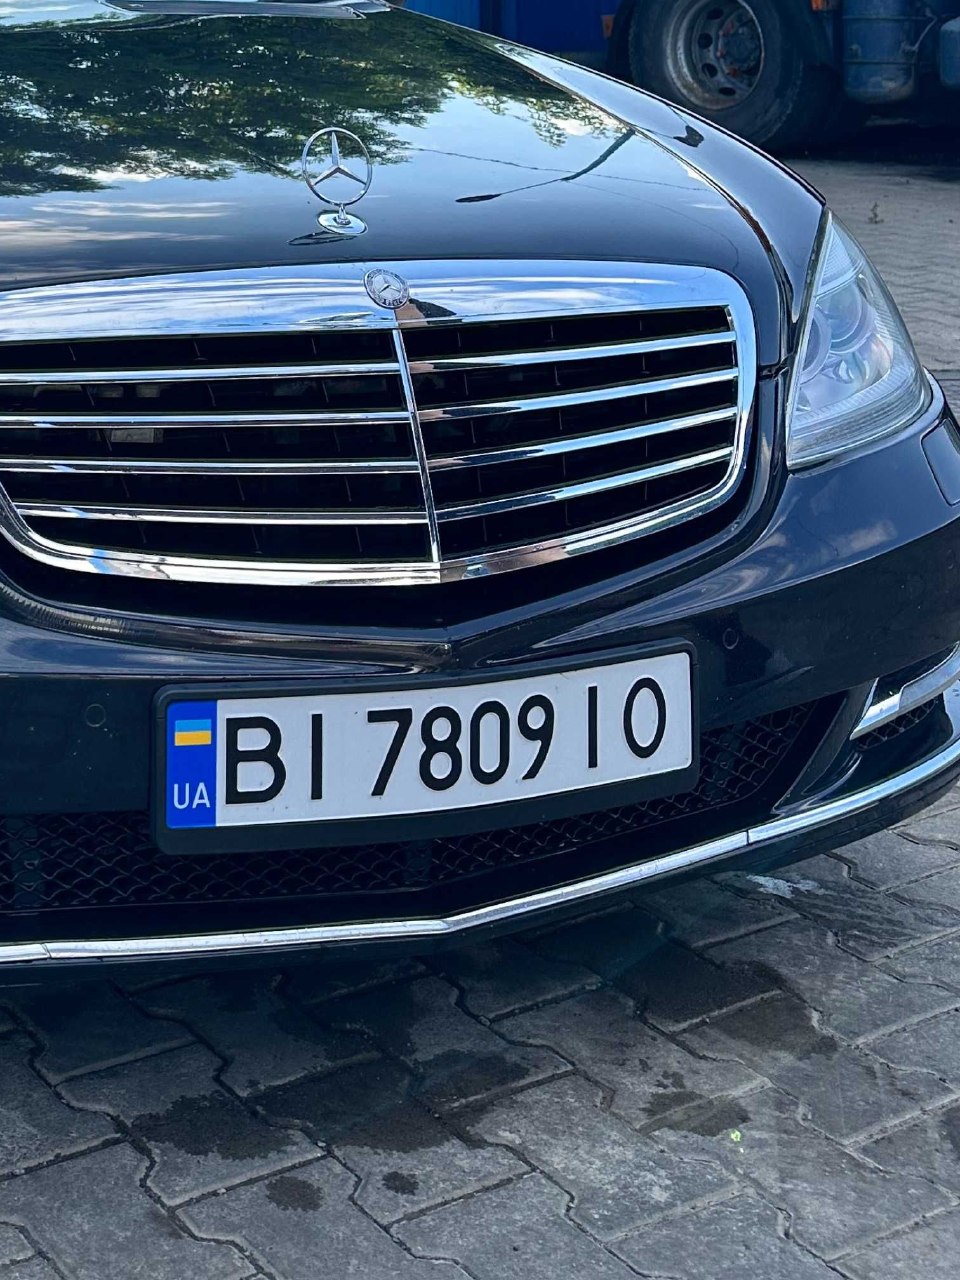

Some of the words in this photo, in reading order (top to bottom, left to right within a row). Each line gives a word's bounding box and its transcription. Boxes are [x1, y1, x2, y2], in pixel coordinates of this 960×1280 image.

[225, 713, 324, 805] BI
[366, 694, 555, 797] 7809
[587, 677, 667, 769] IO
[173, 782, 211, 809] UA
